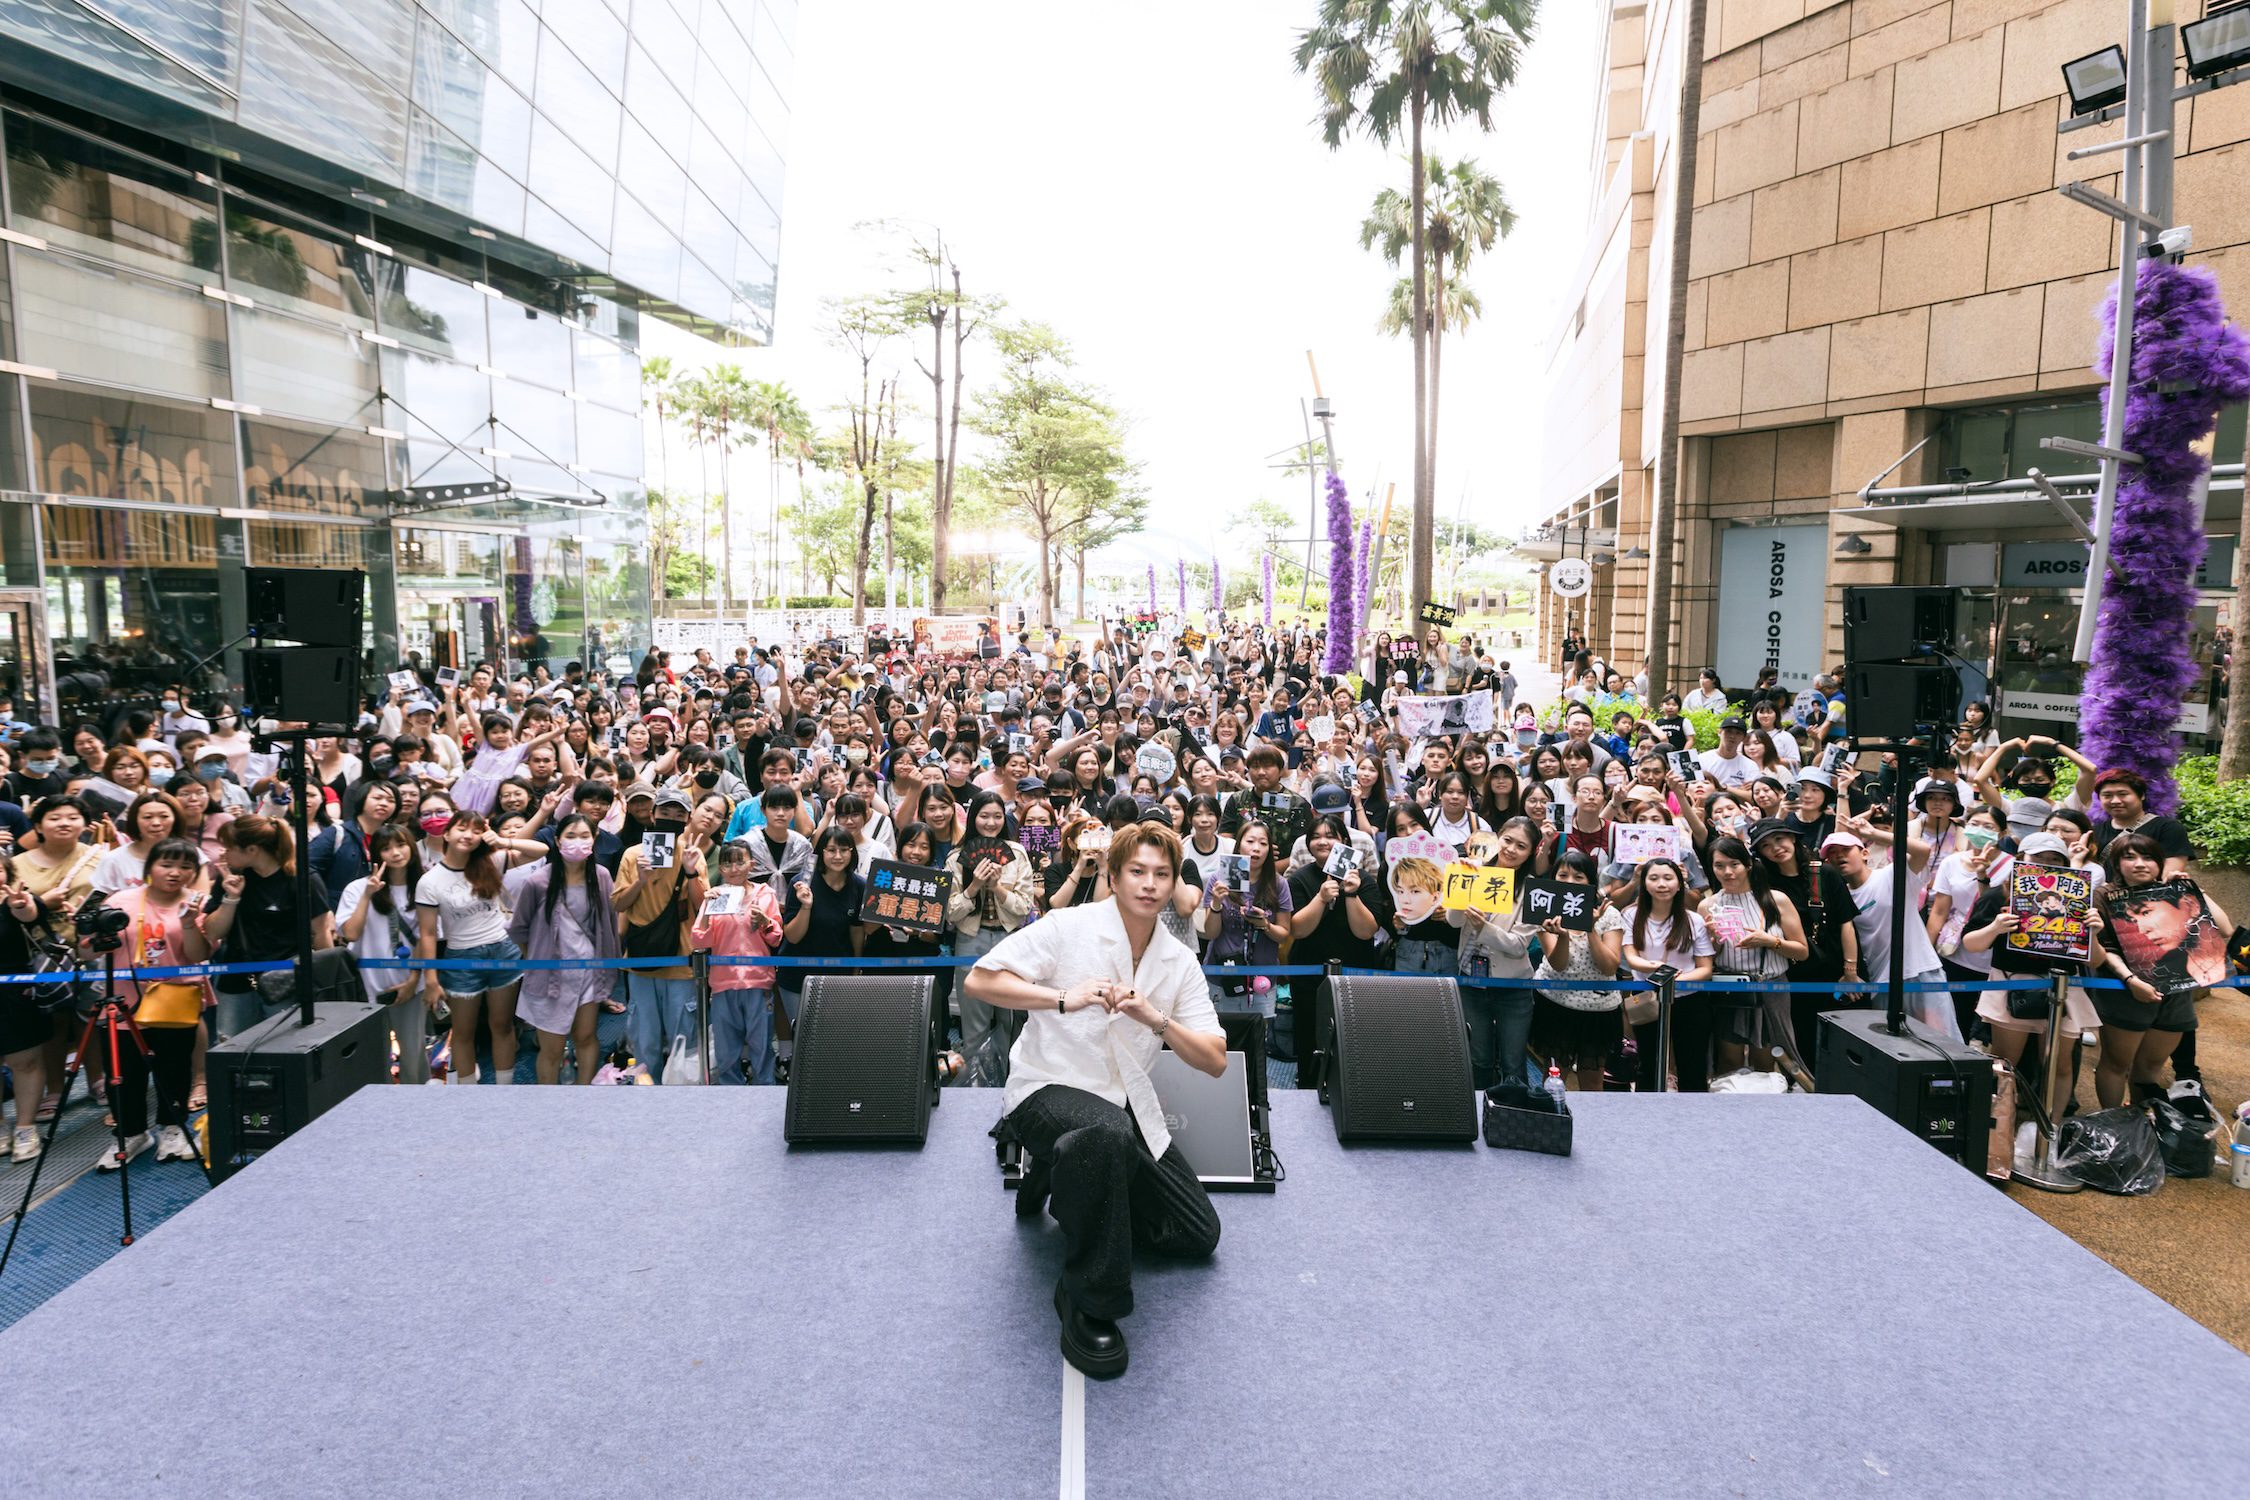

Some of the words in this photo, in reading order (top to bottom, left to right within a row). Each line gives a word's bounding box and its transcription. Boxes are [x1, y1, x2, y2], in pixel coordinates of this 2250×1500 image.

[1769, 540, 1786, 599] AROSA
[2024, 560, 2090, 574] AROS
[1765, 610, 1782, 677] COFFE
[2008, 701, 2038, 710] AROSA
[1019, 826, 1060, 852] 蕭景鴻
[873, 869, 937, 897] 弟表最強
[1447, 873, 1510, 905] 阿弟
[2019, 876, 2039, 892] 我
[2056, 875, 2085, 897] 阿弟
[876, 893, 943, 925] 蕭景鴻
[1529, 888, 1586, 918] 阿弟
[2026, 915, 2082, 935] 24年
